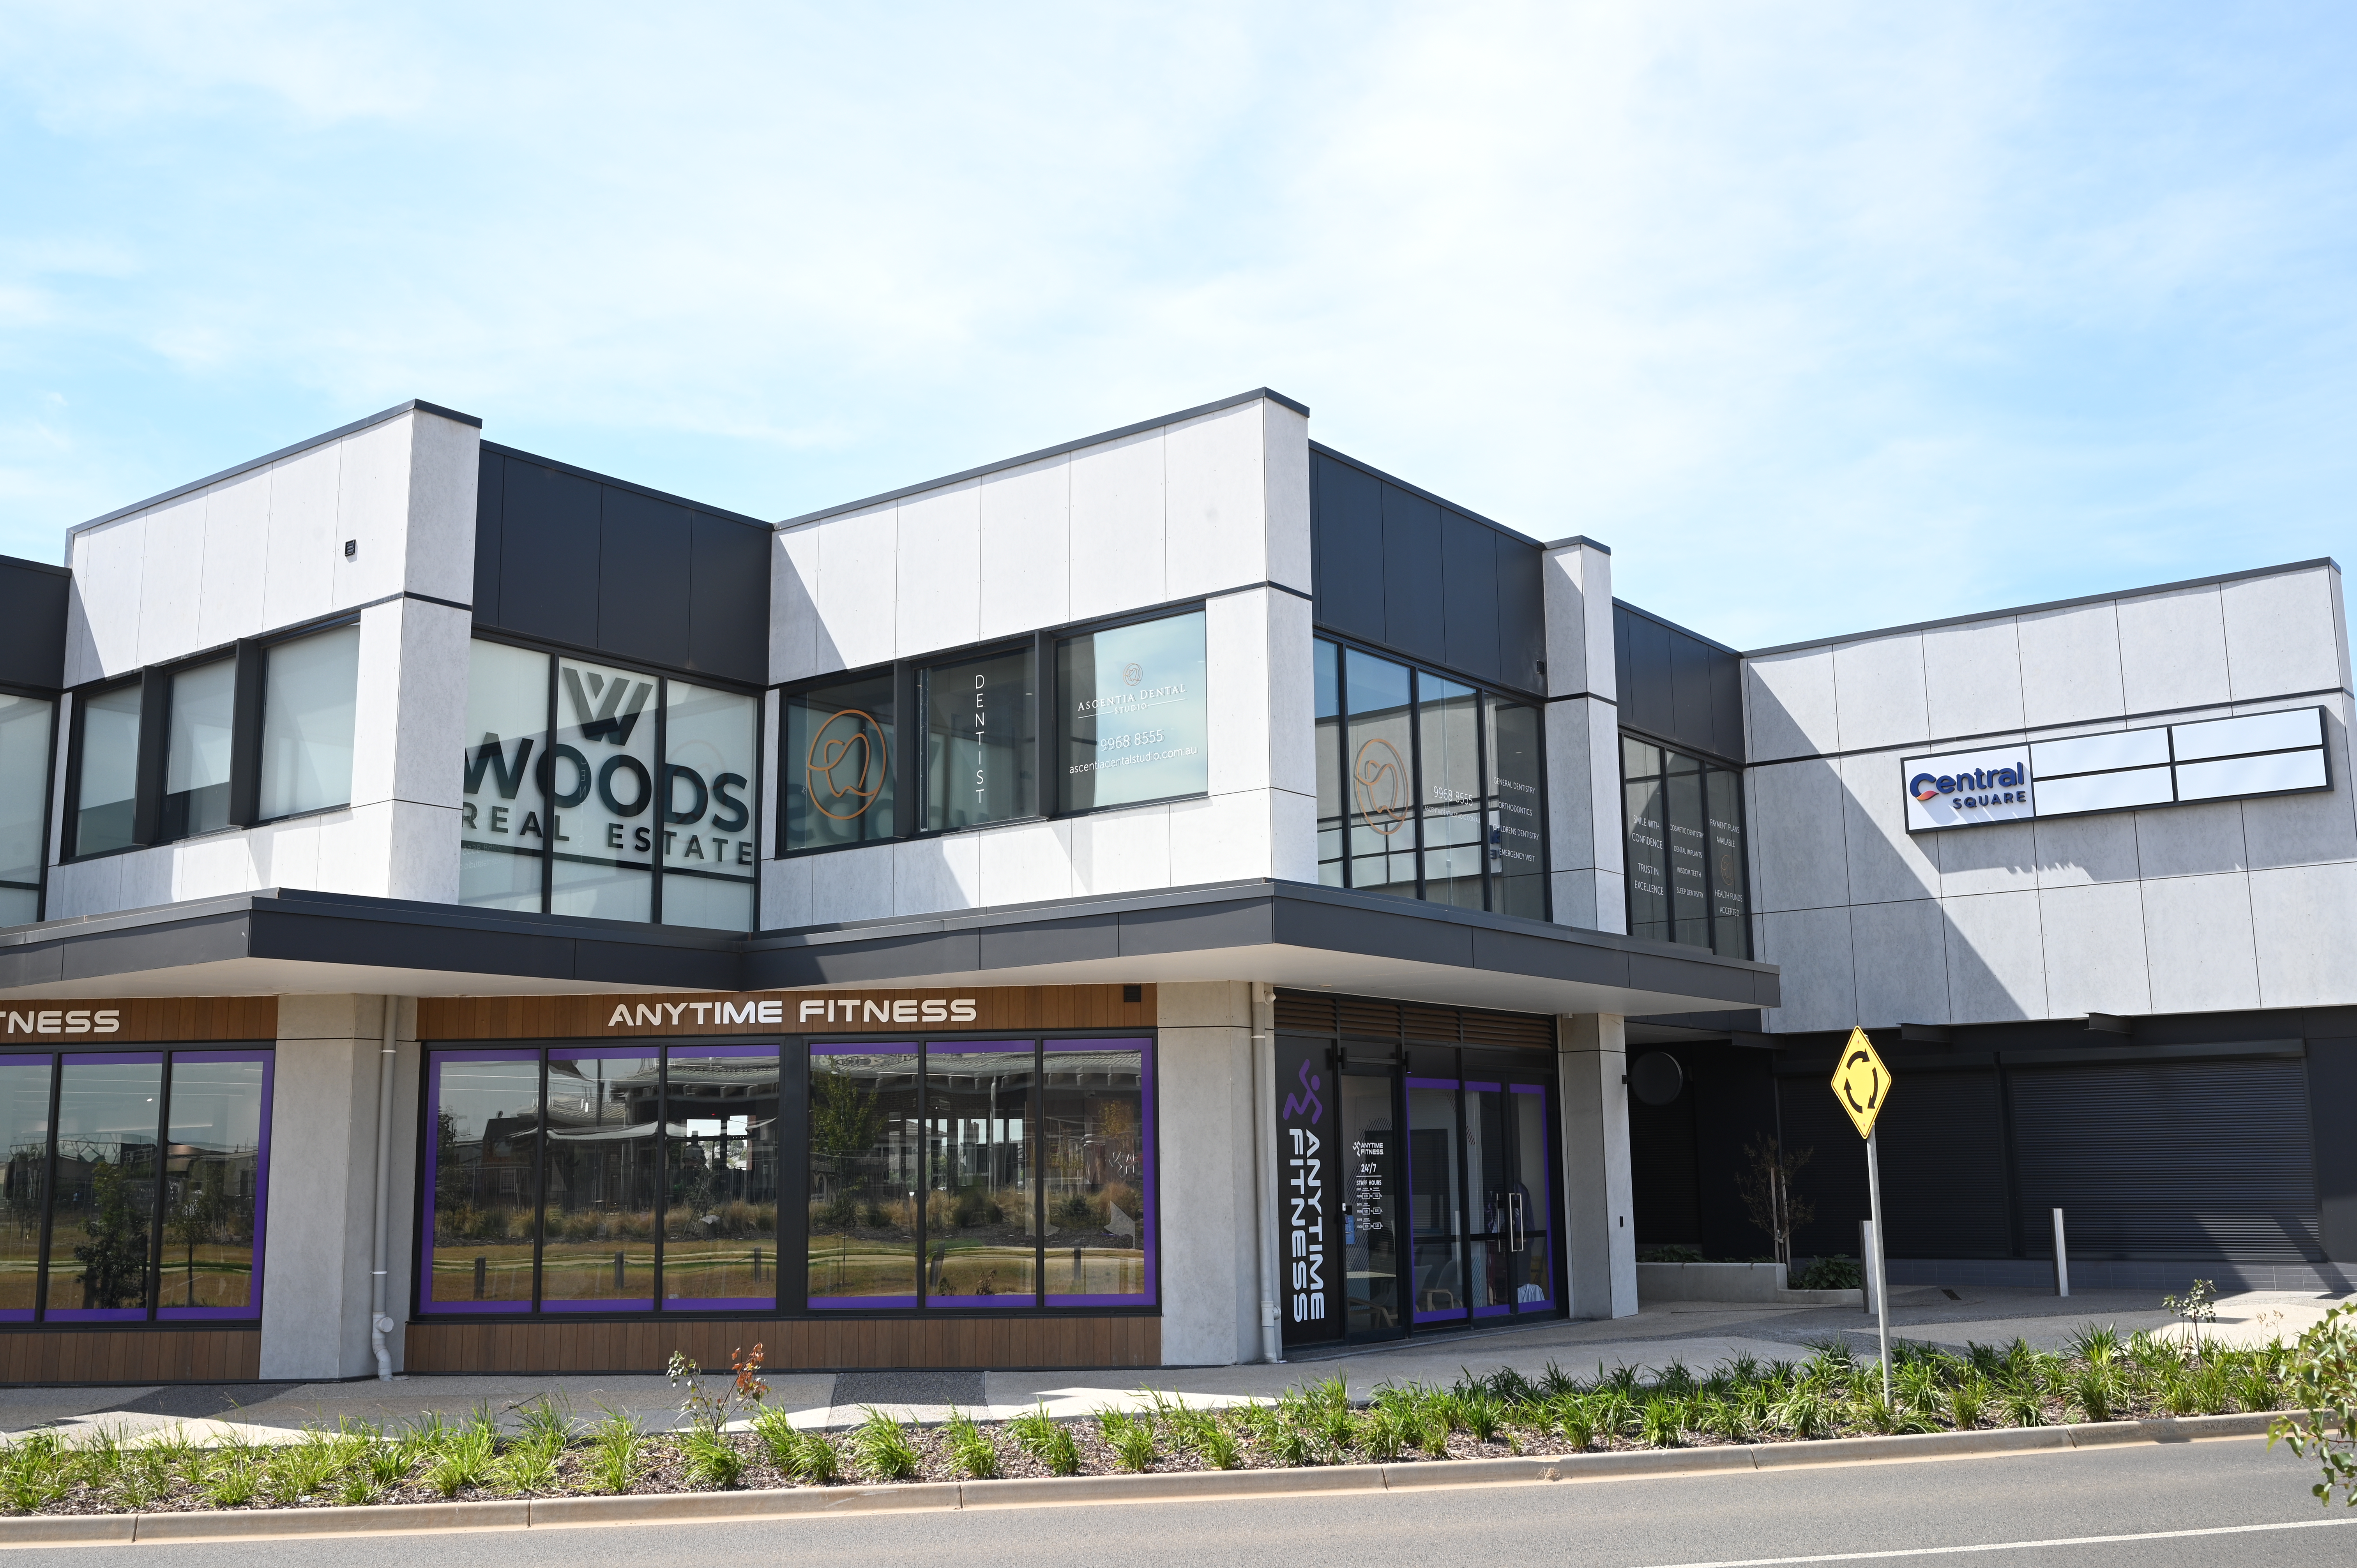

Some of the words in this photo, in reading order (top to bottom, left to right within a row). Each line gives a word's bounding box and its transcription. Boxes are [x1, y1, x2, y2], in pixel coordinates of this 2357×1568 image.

[1078, 693, 1134, 711] ASCENTIA
[1140, 684, 1186, 700] DENTAL
[1115, 703, 1147, 714] STUDIO
[975, 675, 984, 803] DENTIST
[1101, 735, 1130, 751] 9968
[1134, 729, 1163, 745] 8555
[1069, 746, 1196, 774] ascentiadentalstudio.com.au
[463, 732, 749, 832] WOODS
[1493, 777, 1512, 788] GENERAL
[1513, 782, 1535, 794] DENTISTRY
[1910, 761, 2024, 800] Central
[1434, 786, 1453, 801] 9968
[1455, 791, 1473, 806] 8555
[1952, 791, 2026, 809] SQUARE
[1498, 802, 1532, 816] ORTHODONTICS
[1633, 815, 1647, 826] SMILE
[1648, 819, 1660, 830] WITH
[1710, 819, 1727, 830] PAYMENT
[1728, 824, 1740, 833] PLANS
[462, 801, 569, 842] REAL
[608, 823, 753, 866] ESTATE
[1493, 823, 1516, 835] CHILDRENS
[1518, 828, 1539, 840] DENTISTRY
[1670, 824, 1686, 834] COSMETIC
[1687, 829, 1704, 839] DENTISTRY
[1632, 832, 1663, 849] CONFIDENCE
[1716, 836, 1735, 848] AVAILABLE
[1499, 848, 1524, 860] EMERGENCY
[1525, 853, 1535, 862] VISIT
[1674, 846, 1686, 855] DENTAL
[1687, 849, 1702, 858] IMPLANTS
[1638, 863, 1653, 874] TRUST
[1654, 867, 1659, 876] IN
[1677, 867, 1691, 875] WISDOM
[1635, 880, 1664, 895] EXCELLENCE
[1687, 890, 1703, 898] DENTISTRY
[1715, 889, 1729, 899] HEALTH
[1730, 893, 1743, 902] FUNDS
[1720, 906, 1740, 916] ACCEPTED
[608, 1001, 782, 1026] ANYTIME
[800, 999, 977, 1023] FITNESS
[0, 1010, 120, 1033] NESS
[1289, 1128, 1308, 1323] FITNESS
[1306, 1129, 1325, 1320] ANYTIME
